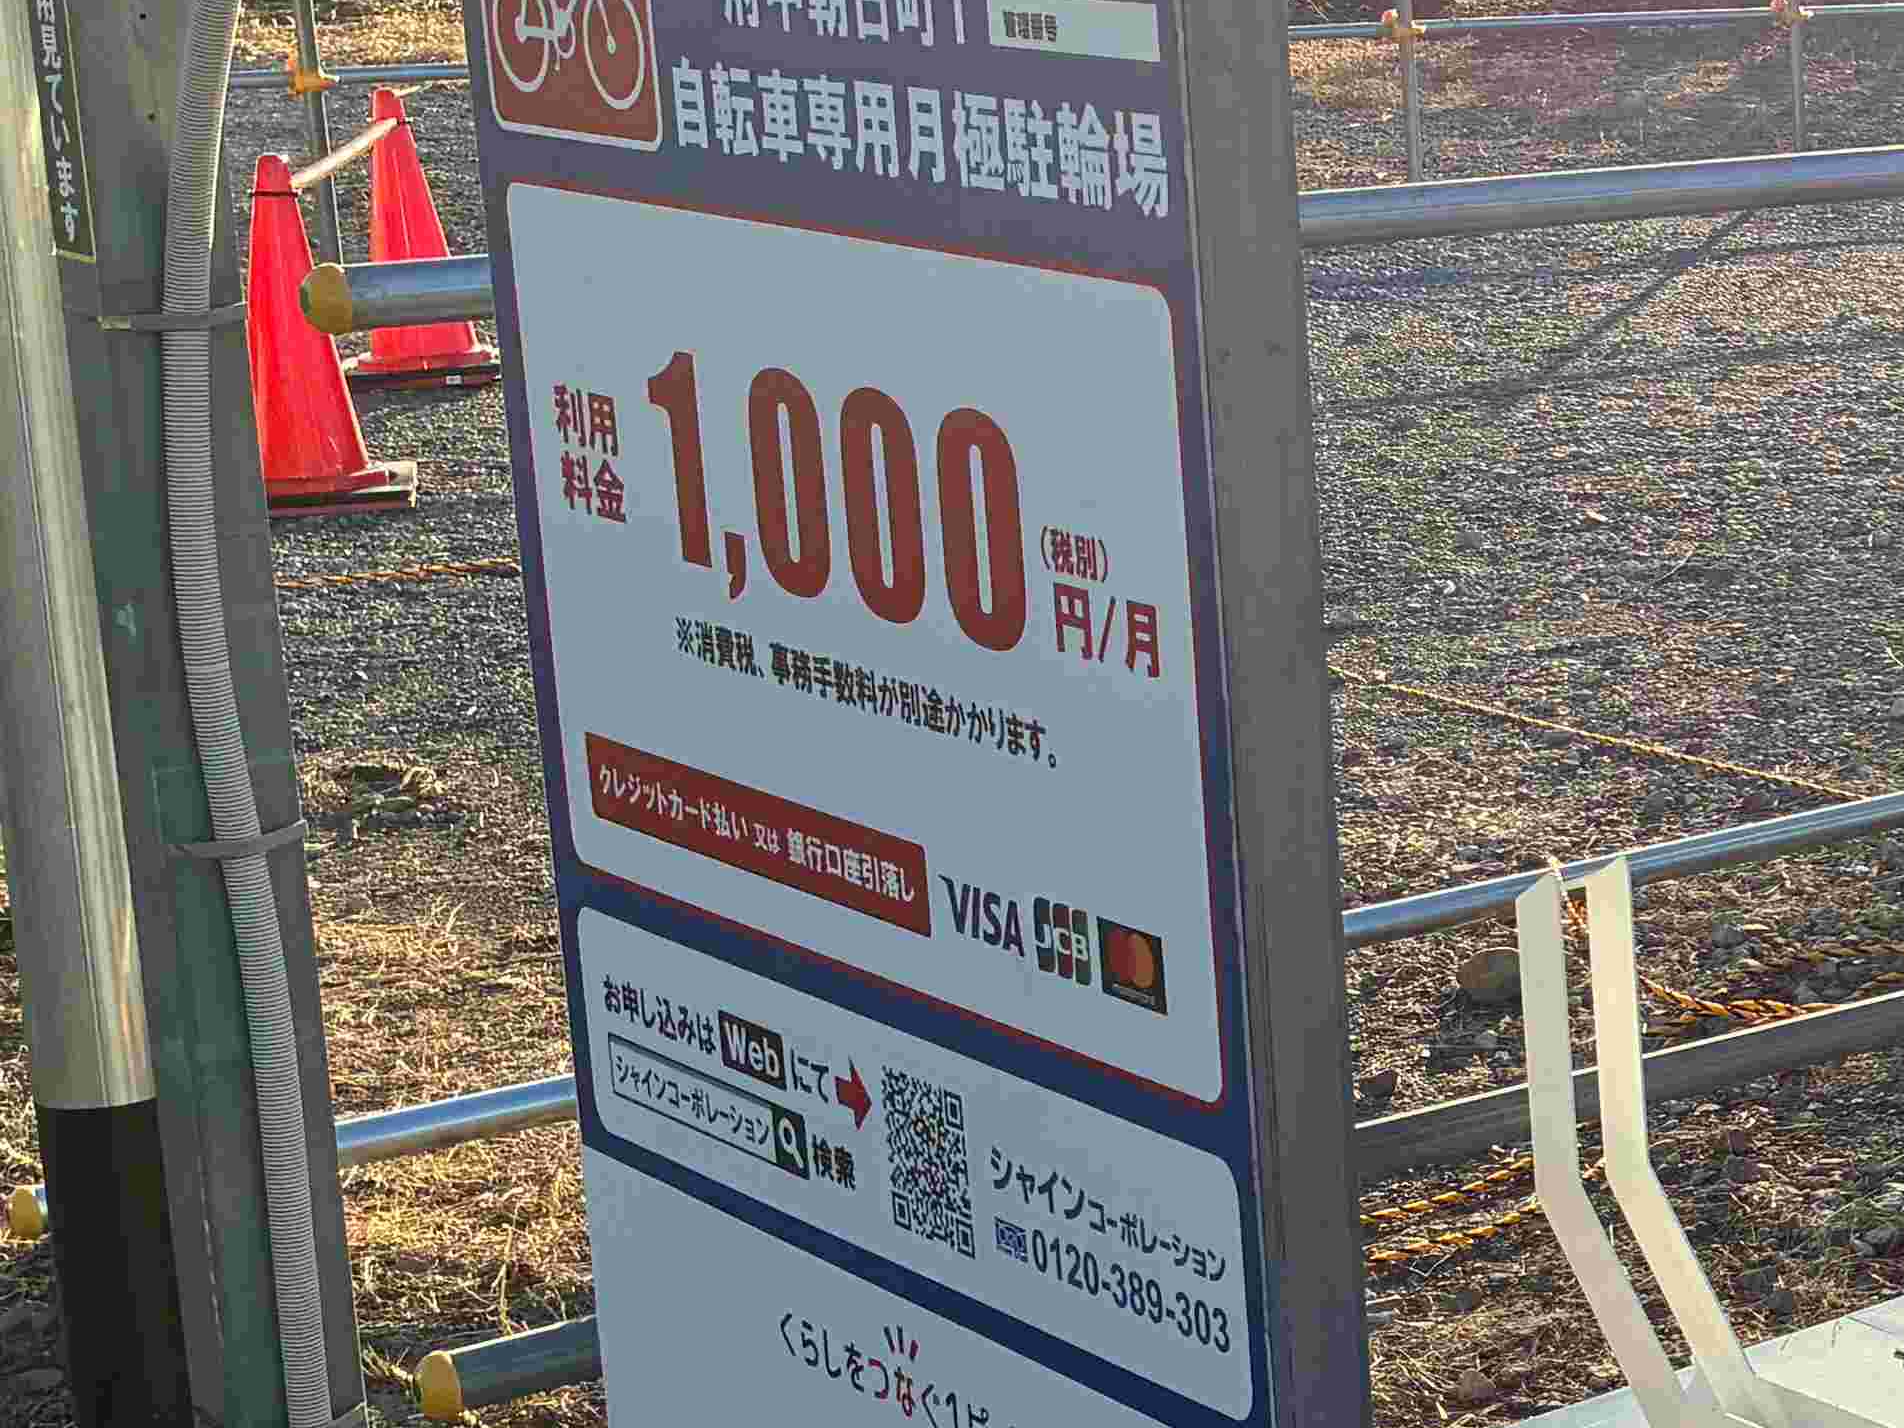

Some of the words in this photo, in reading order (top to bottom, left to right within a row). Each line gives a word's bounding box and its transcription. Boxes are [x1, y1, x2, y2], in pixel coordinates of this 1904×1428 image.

[671, 56, 1169, 219] 自転車専用月極駐輪場
[553, 384, 619, 457] 利用
[560, 450, 628, 523] 料金
[647, 351, 1028, 653] 1,000
[599, 763, 749, 842] クレジットカード払い
[787, 827, 915, 903] 銀行口座引落し
[938, 874, 1025, 959] VISA
[603, 973, 717, 1055] お申し込みは
[724, 1020, 781, 1080] Web
[790, 1045, 830, 1105] にて
[616, 1055, 770, 1146] シャインコーポレーション
[811, 1133, 857, 1191] 検索
[990, 1145, 1227, 1282] シャインコーポレーション
[1031, 1228, 1231, 1354] 0120-389-303
